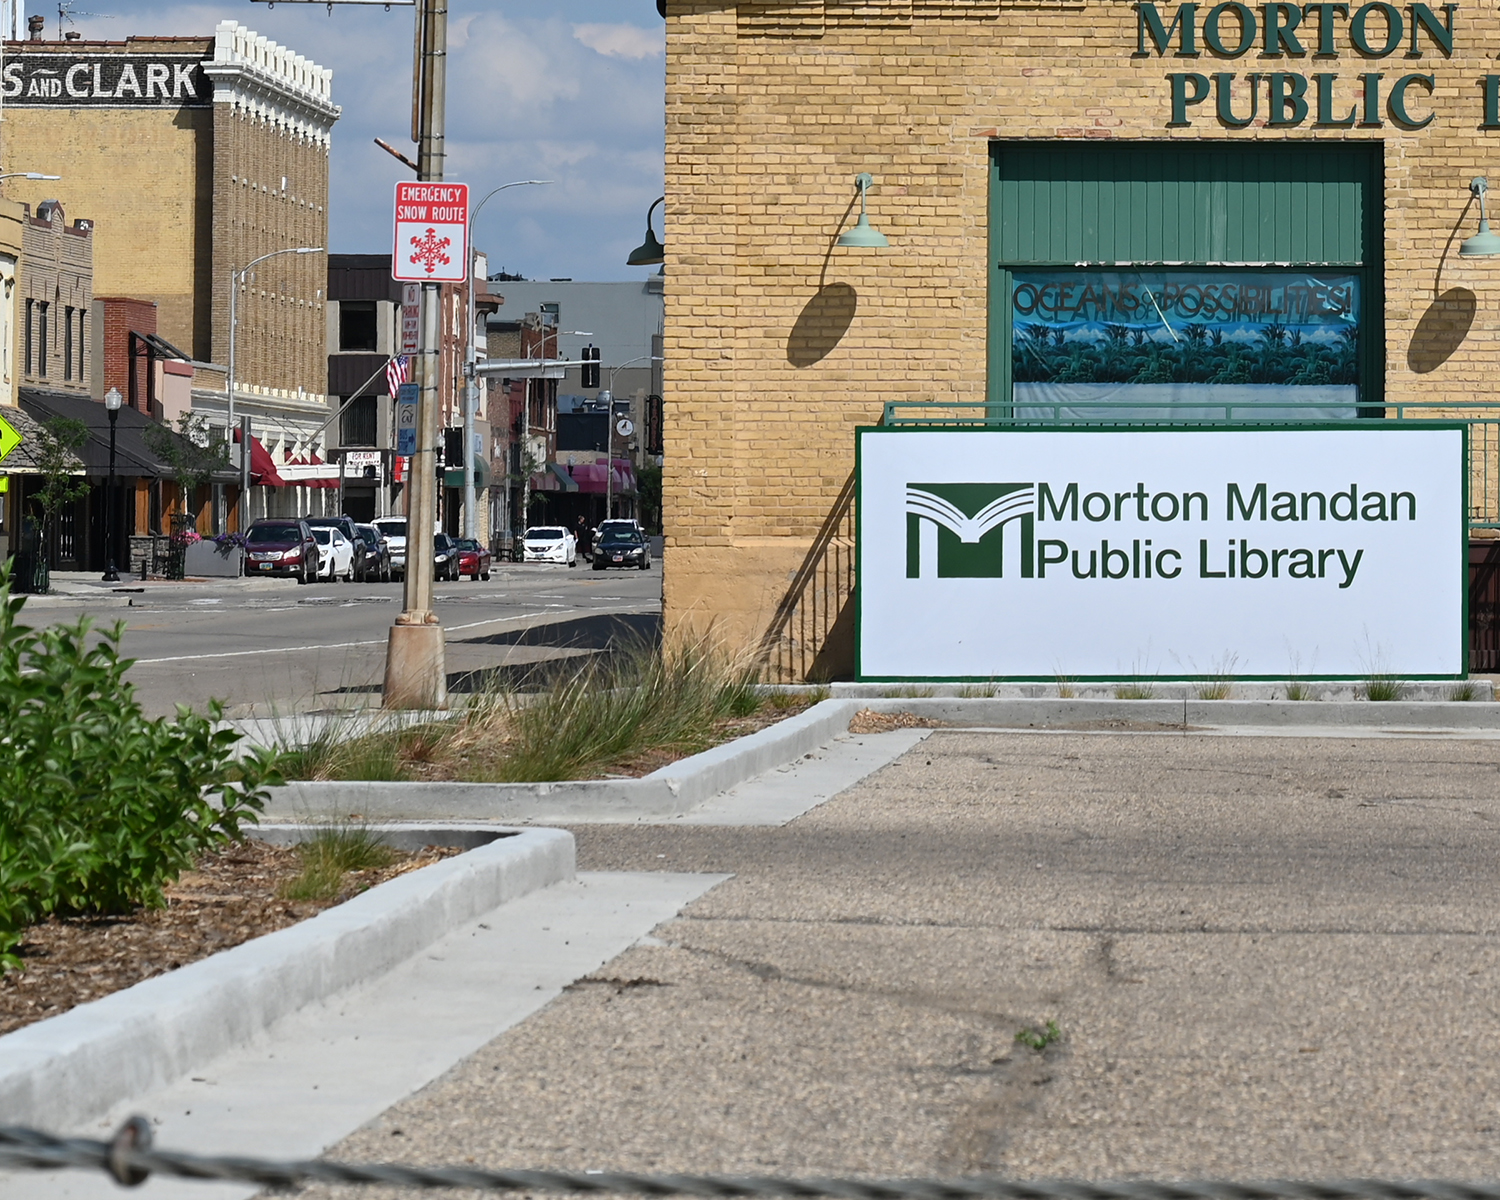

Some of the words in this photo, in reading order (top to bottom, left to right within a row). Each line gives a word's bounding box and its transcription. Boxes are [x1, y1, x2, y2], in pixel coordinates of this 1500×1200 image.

[1132, 1, 1458, 57] MORTON
[27, 77, 62, 98] AND
[65, 63, 198, 98] CLARK
[1165, 71, 1435, 129] PUBLIC
[401, 186, 462, 202] EMERGENCY
[397, 205, 427, 220] SNOW
[431, 206, 465, 221] ROUTE
[1014, 282, 1140, 314] OCEANS
[1037, 482, 1209, 522] Morton
[1226, 482, 1417, 522] Mandan
[1037, 538, 1182, 579] Public
[1199, 538, 1364, 588] Library
